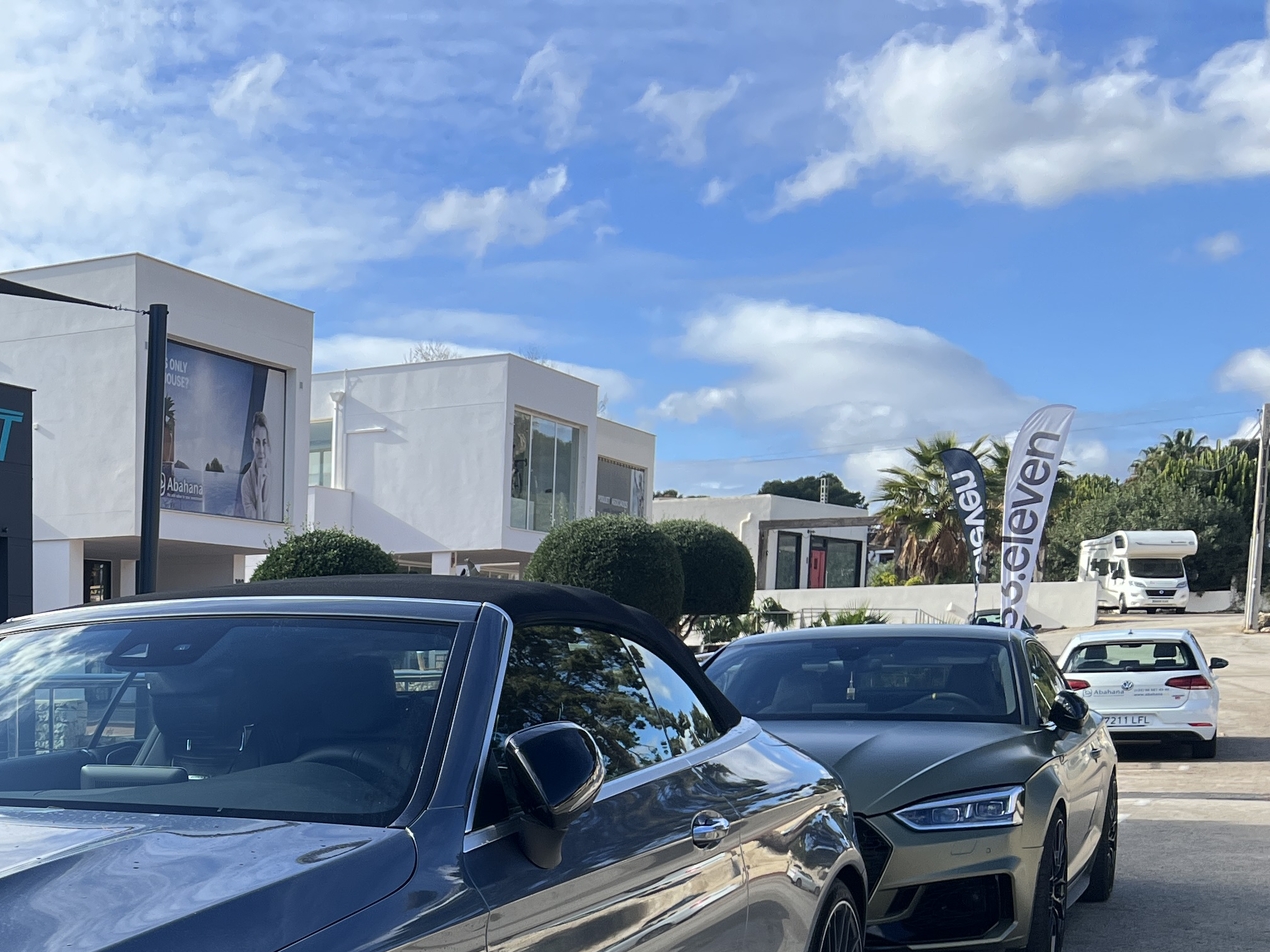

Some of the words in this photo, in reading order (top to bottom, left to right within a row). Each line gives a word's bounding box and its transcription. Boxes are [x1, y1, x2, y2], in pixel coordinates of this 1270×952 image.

[169, 358, 188, 374] ONLY
[165, 372, 190, 389] OUSE?
[166, 477, 204, 495] Abahana
[1093, 688, 1125, 696] Abahana
[1104, 716, 1128, 725] 7211
[1131, 716, 1150, 724] LFL
